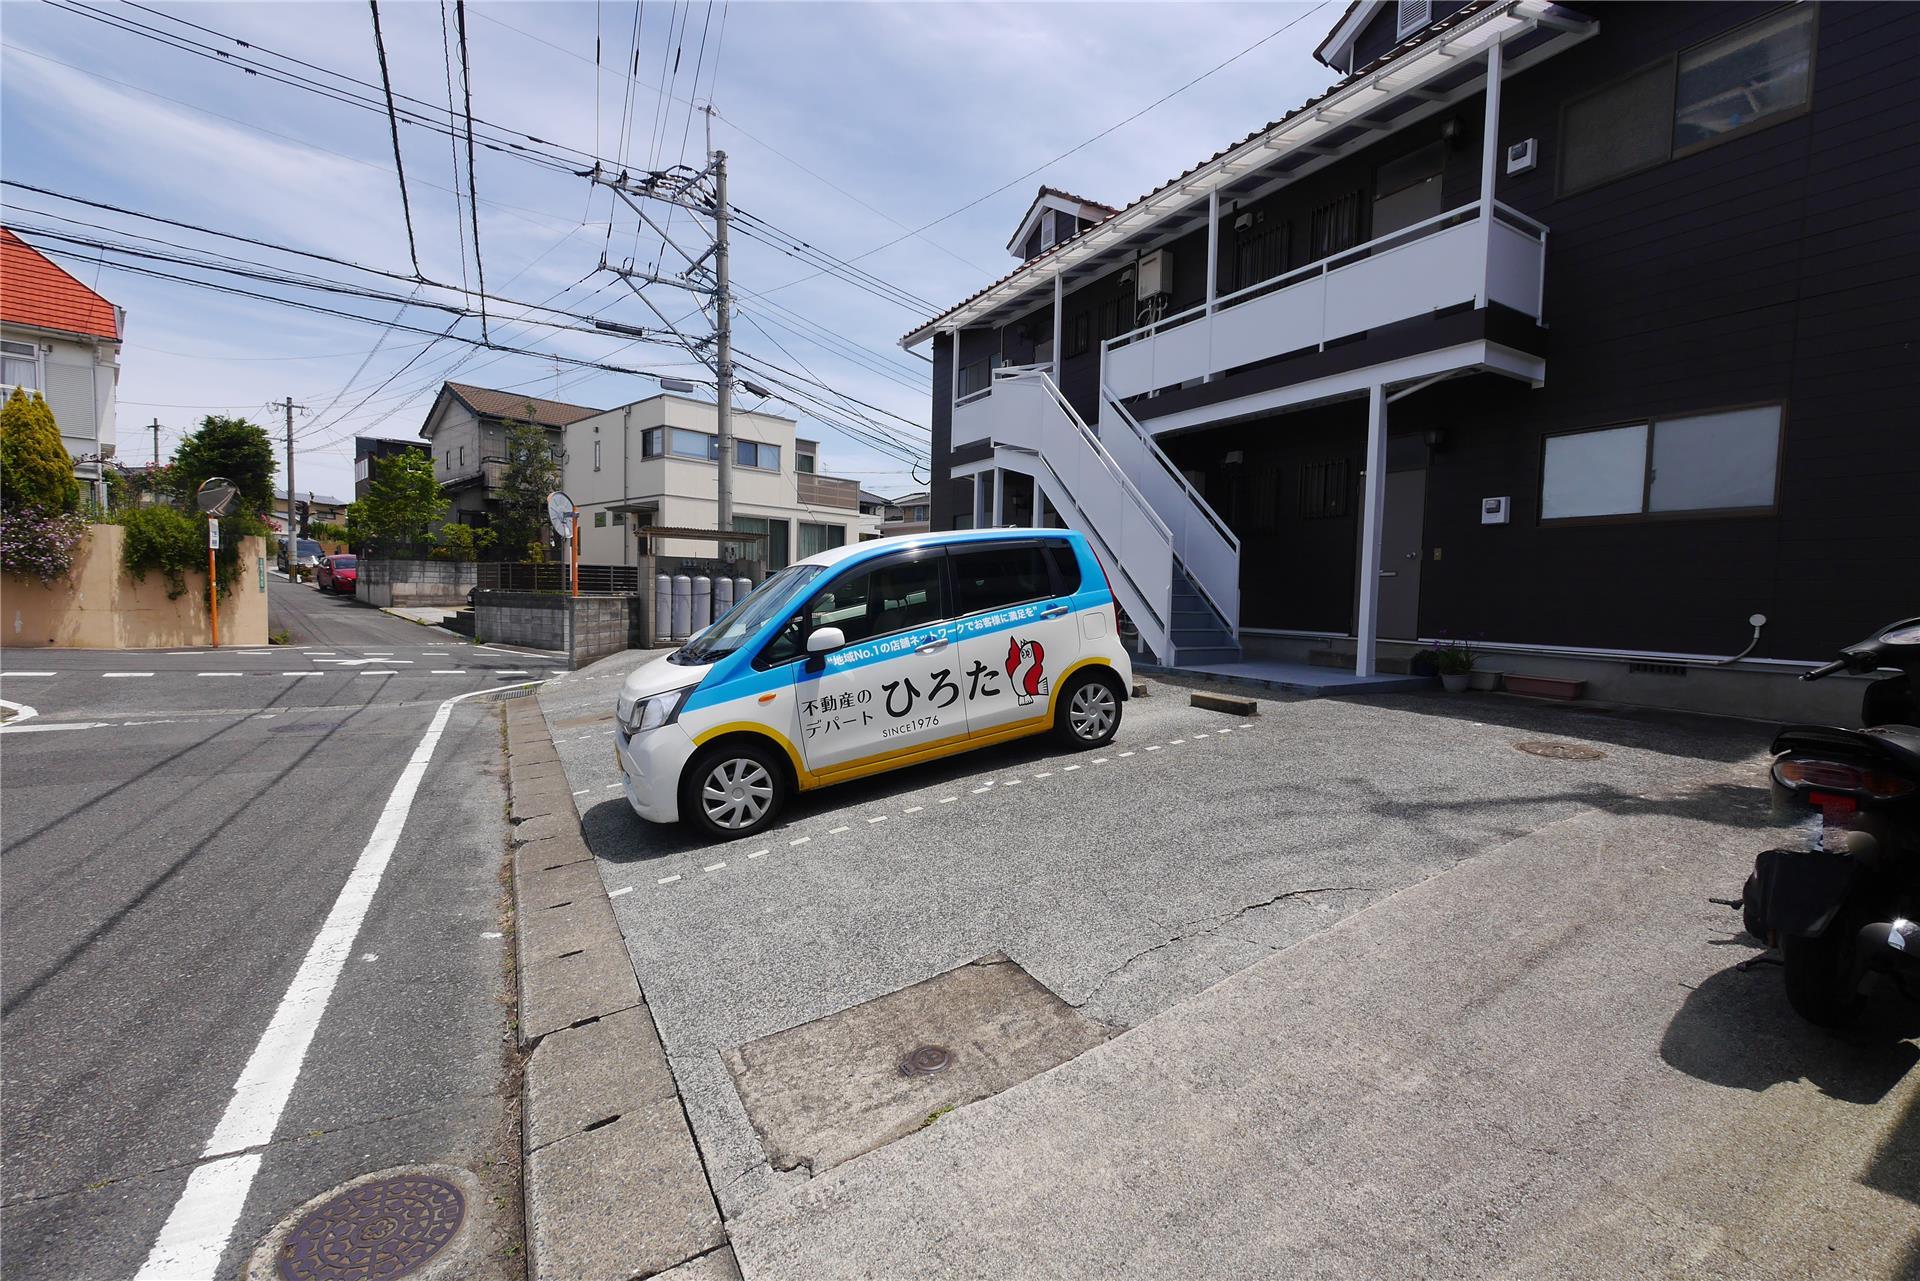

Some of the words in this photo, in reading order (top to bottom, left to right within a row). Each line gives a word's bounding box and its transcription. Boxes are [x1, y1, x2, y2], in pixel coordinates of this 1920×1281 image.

[801, 689, 872, 717] 不動産の
[881, 660, 1001, 718] ひろた
[805, 711, 874, 739] デパート
